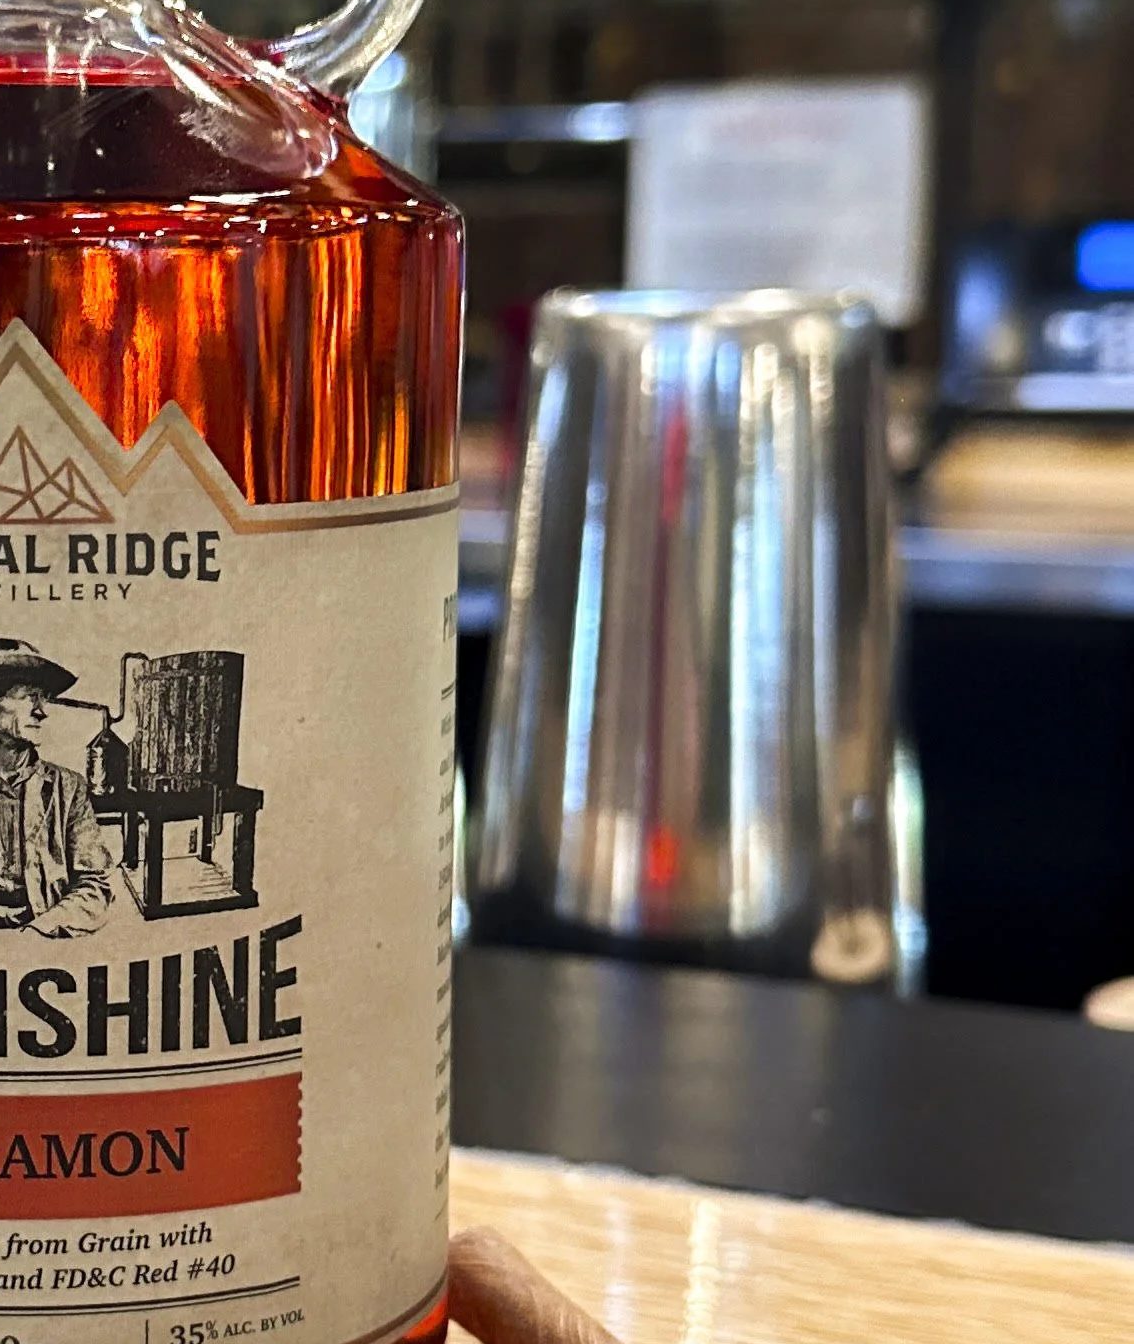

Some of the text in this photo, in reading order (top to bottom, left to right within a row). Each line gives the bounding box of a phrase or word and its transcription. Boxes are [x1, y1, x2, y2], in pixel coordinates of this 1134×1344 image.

[68, 530, 221, 582] RIDGE
[1, 1232, 68, 1260] from
[78, 1228, 150, 1253] Grain
[159, 1221, 213, 1248] with
[50, 1264, 127, 1290] FD&C
[132, 1259, 178, 1285] Red
[186, 1253, 236, 1280] #40
[223, 1321, 256, 1338] ALC.
[260, 1316, 278, 1332] BY
